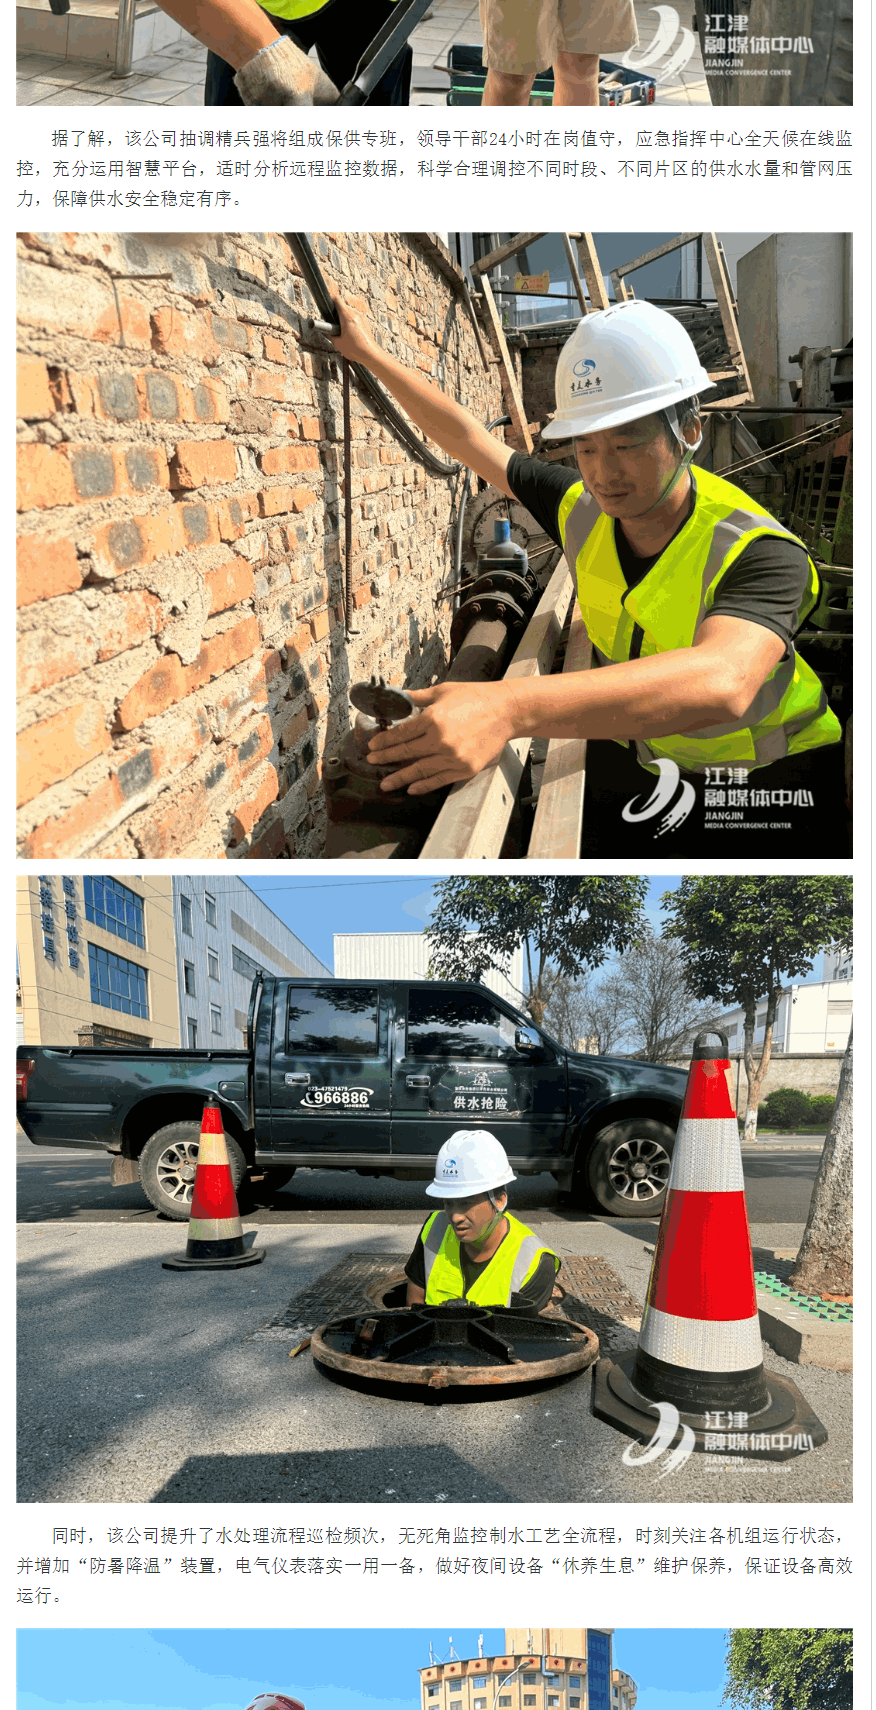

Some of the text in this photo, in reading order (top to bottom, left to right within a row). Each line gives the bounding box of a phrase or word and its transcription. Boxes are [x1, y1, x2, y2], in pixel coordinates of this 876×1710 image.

[16, 189, 239, 208] 力，保障供水安全稳定有序。
[314, 1092, 369, 1104] 966886
[453, 1095, 508, 1110] 供水抢险
[16, 1586, 59, 1605] 运行。
